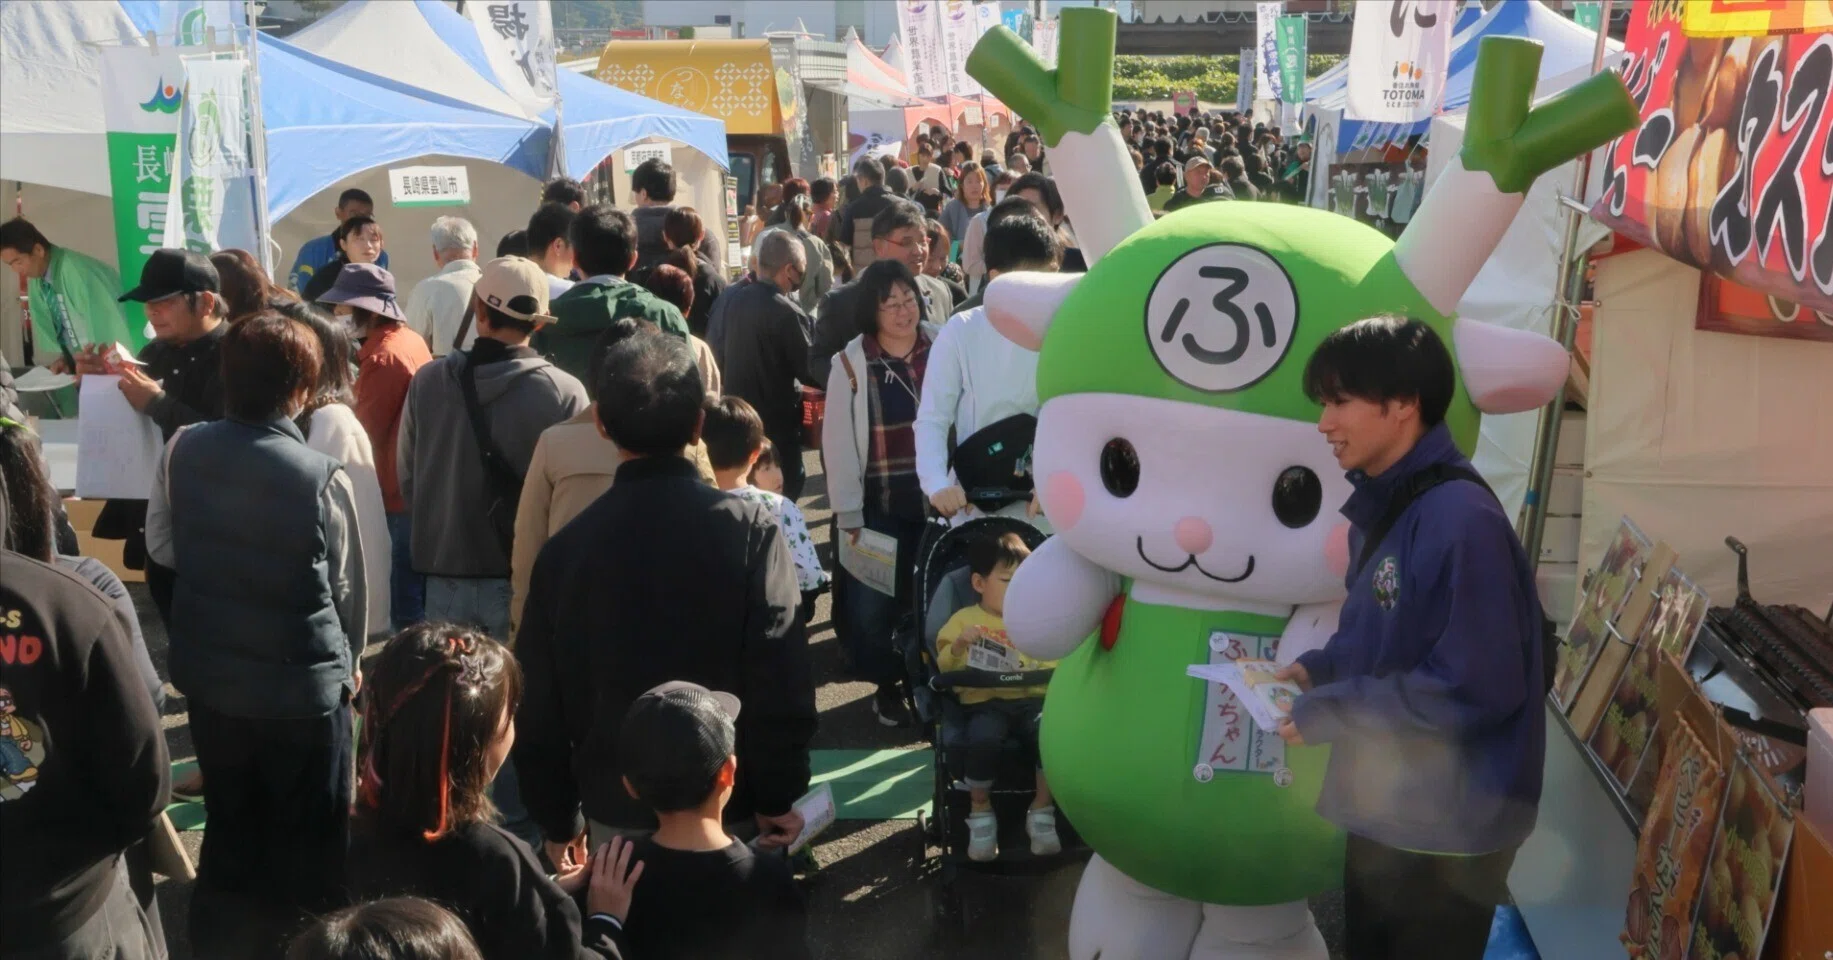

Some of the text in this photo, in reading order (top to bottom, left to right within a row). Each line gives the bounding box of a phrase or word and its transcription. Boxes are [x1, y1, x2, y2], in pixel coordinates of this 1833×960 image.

[1382, 89, 1425, 100] TOTOMA
[402, 175, 458, 196] 長崎県雲仙市
[1160, 265, 1277, 365] ふ
[1000, 673, 1024, 682] Combi
[1208, 638, 1248, 765] ふちゃん
